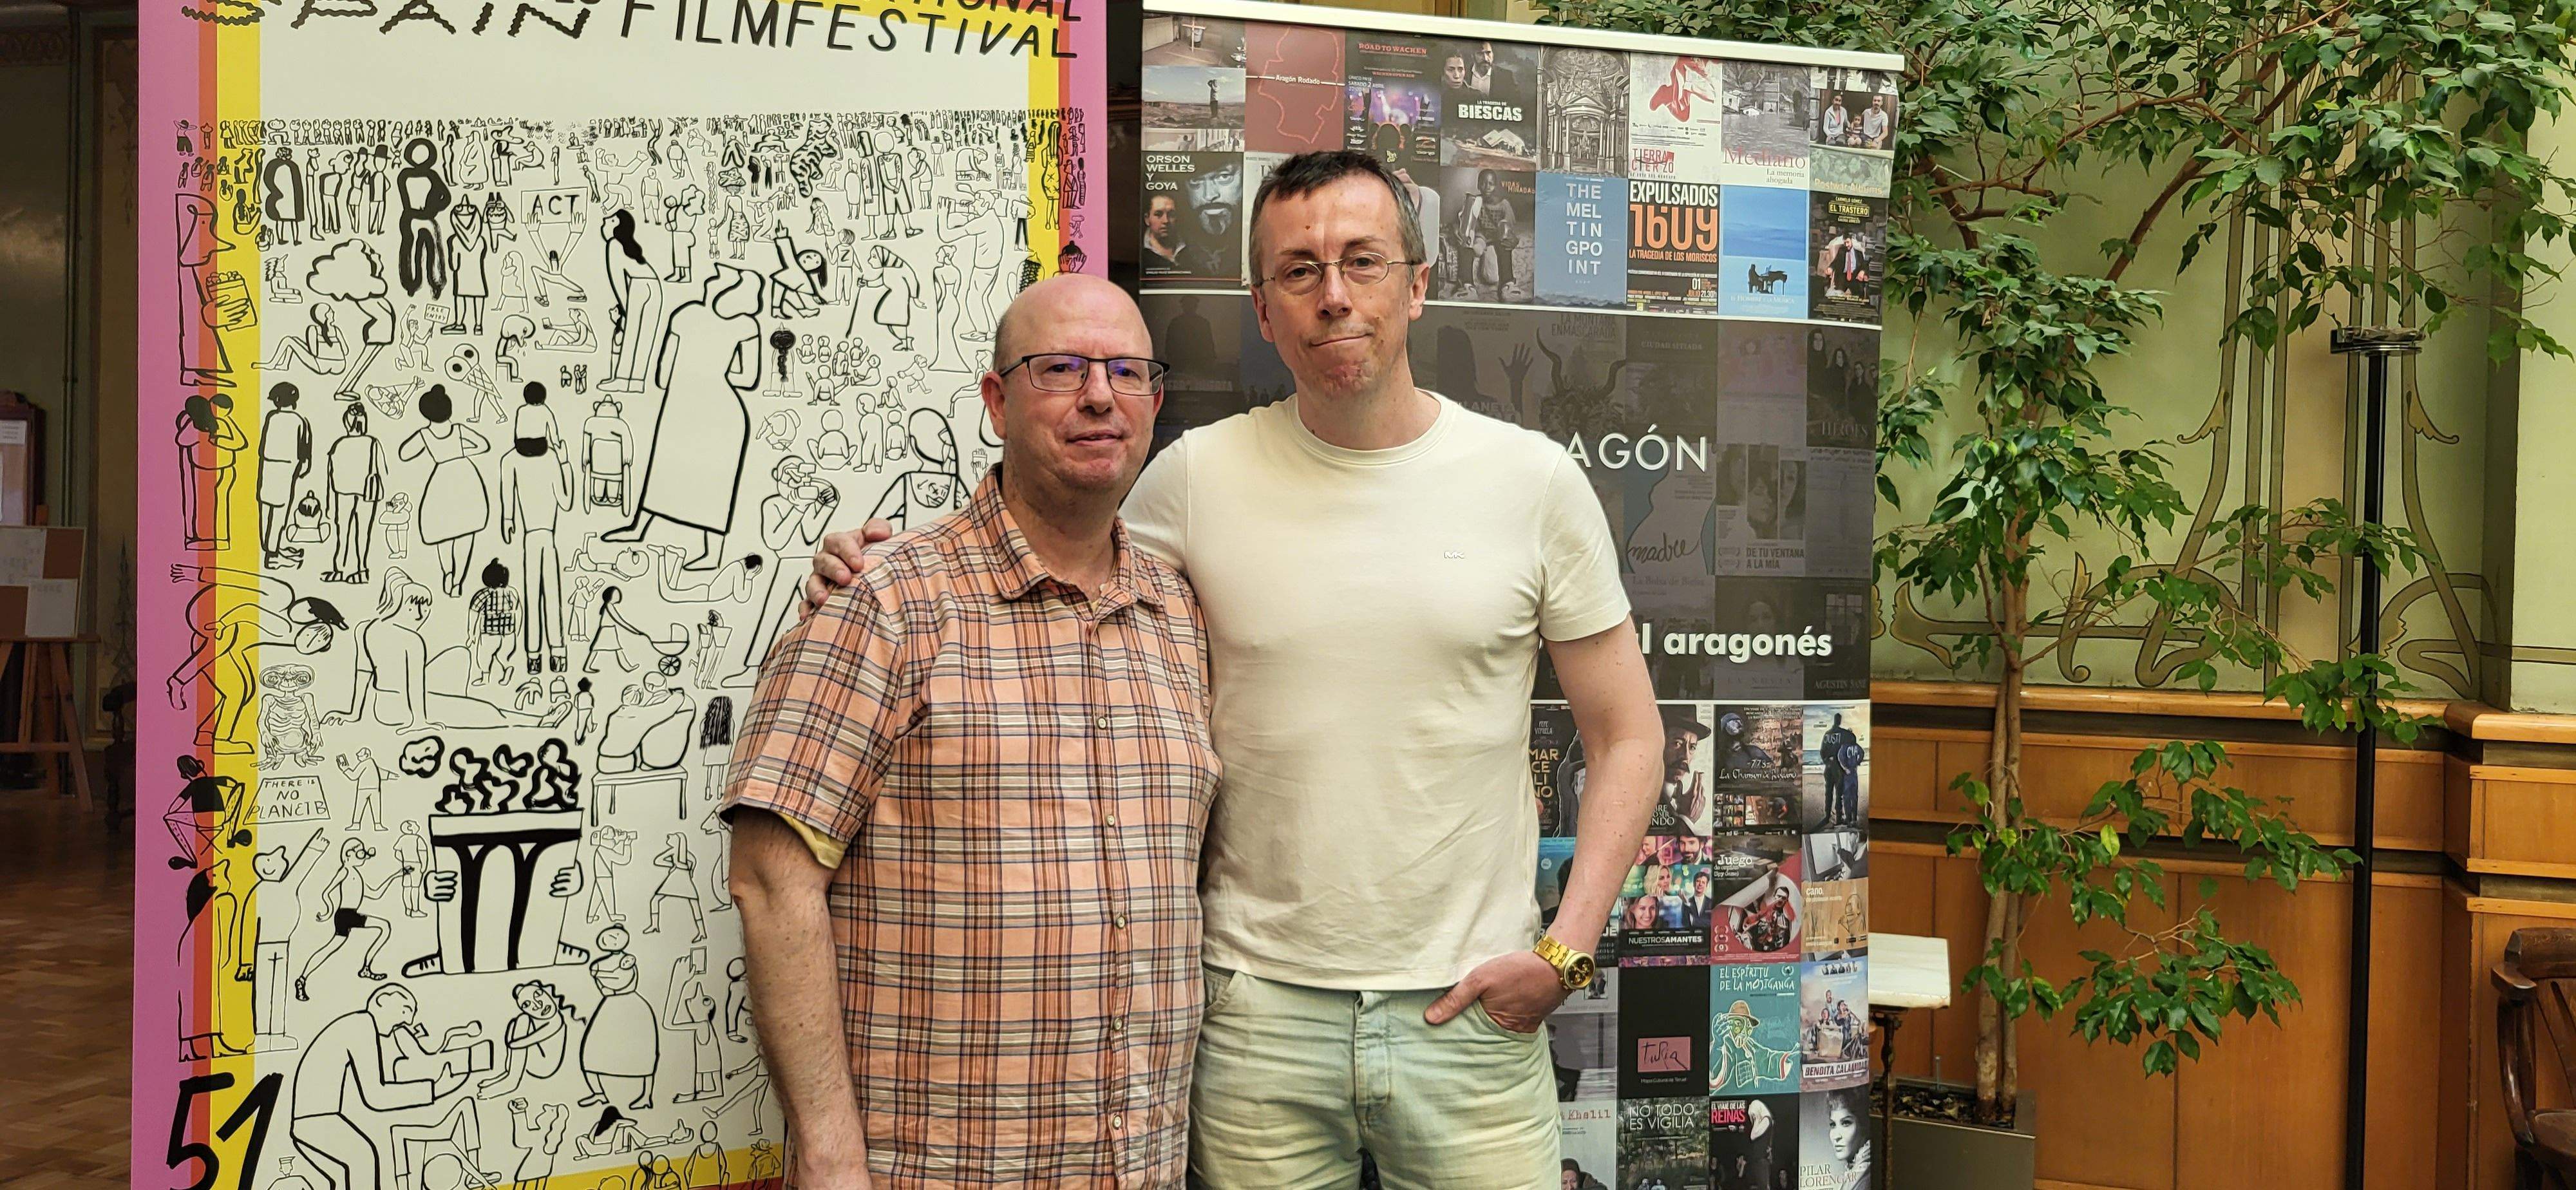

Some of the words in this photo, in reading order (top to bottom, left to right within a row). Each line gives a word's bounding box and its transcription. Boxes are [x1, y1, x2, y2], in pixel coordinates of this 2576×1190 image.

[1276, 75, 1296, 83] Aragón
[1298, 76, 1320, 84] Rodado
[1457, 104, 1523, 122] BIESCAS
[1146, 155, 1190, 164] ORSON
[1722, 147, 1806, 169] Mediano
[1146, 164, 1196, 173] WELLES
[1776, 169, 1804, 178] memoria
[1146, 173, 1154, 182] Y
[1146, 182, 1179, 191] GOYA
[1566, 183, 1602, 200] THE
[1629, 181, 1718, 207] EXPULSADOS
[532, 194, 580, 216] ACT
[1566, 202, 1602, 219] MEL
[1838, 205, 1869, 216] TRASTERO
[1566, 221, 1602, 238] TIN
[1629, 204, 1718, 252] 1609
[1566, 240, 1603, 256] GPO
[1629, 249, 1636, 258] LA
[1636, 250, 1664, 261] TRAGEDIA
[1665, 251, 1672, 261] DE
[1673, 252, 1684, 261] LOS
[1685, 252, 1717, 263] MORISCOS
[1569, 259, 1601, 275] INT
[1692, 278, 1701, 290] 01
[1567, 424, 1708, 473] AGÓN
[1746, 547, 1757, 558] DE
[1758, 547, 1769, 558] TU
[1770, 547, 1804, 558] VENTANA
[1746, 558, 1751, 569] A
[1754, 558, 1763, 569] LA
[1663, 623, 1833, 663] aragonés
[1529, 748, 1558, 760] MAR
[1531, 761, 1550, 773] CE
[1534, 773, 1547, 785] LI
[276, 789, 300, 800] NO
[247, 801, 311, 820] PLANET
[1651, 817, 1675, 826] NDO
[1717, 854, 1753, 868] Juego
[1602, 926, 1618, 936] JE
[1719, 966, 1730, 978] EL
[1732, 965, 1769, 981] ESPÍRITU
[1719, 980, 1731, 991] DE
[1733, 978, 1743, 992] LA
[1745, 977, 1795, 991] MOJIGANGA
[1805, 1065, 1835, 1077] BENDITA
[1568, 1109, 1611, 1120] Khalil
[1629, 1104, 1651, 1118] NO
[1655, 1103, 1694, 1117] TODO
[1711, 1109, 1746, 1124] REINAS
[1629, 1117, 1643, 1131] ES
[1647, 1115, 1694, 1130] VIGILIA
[1800, 1164, 1831, 1176] PILAR
[1800, 1171, 1857, 1188] LORENGAR
